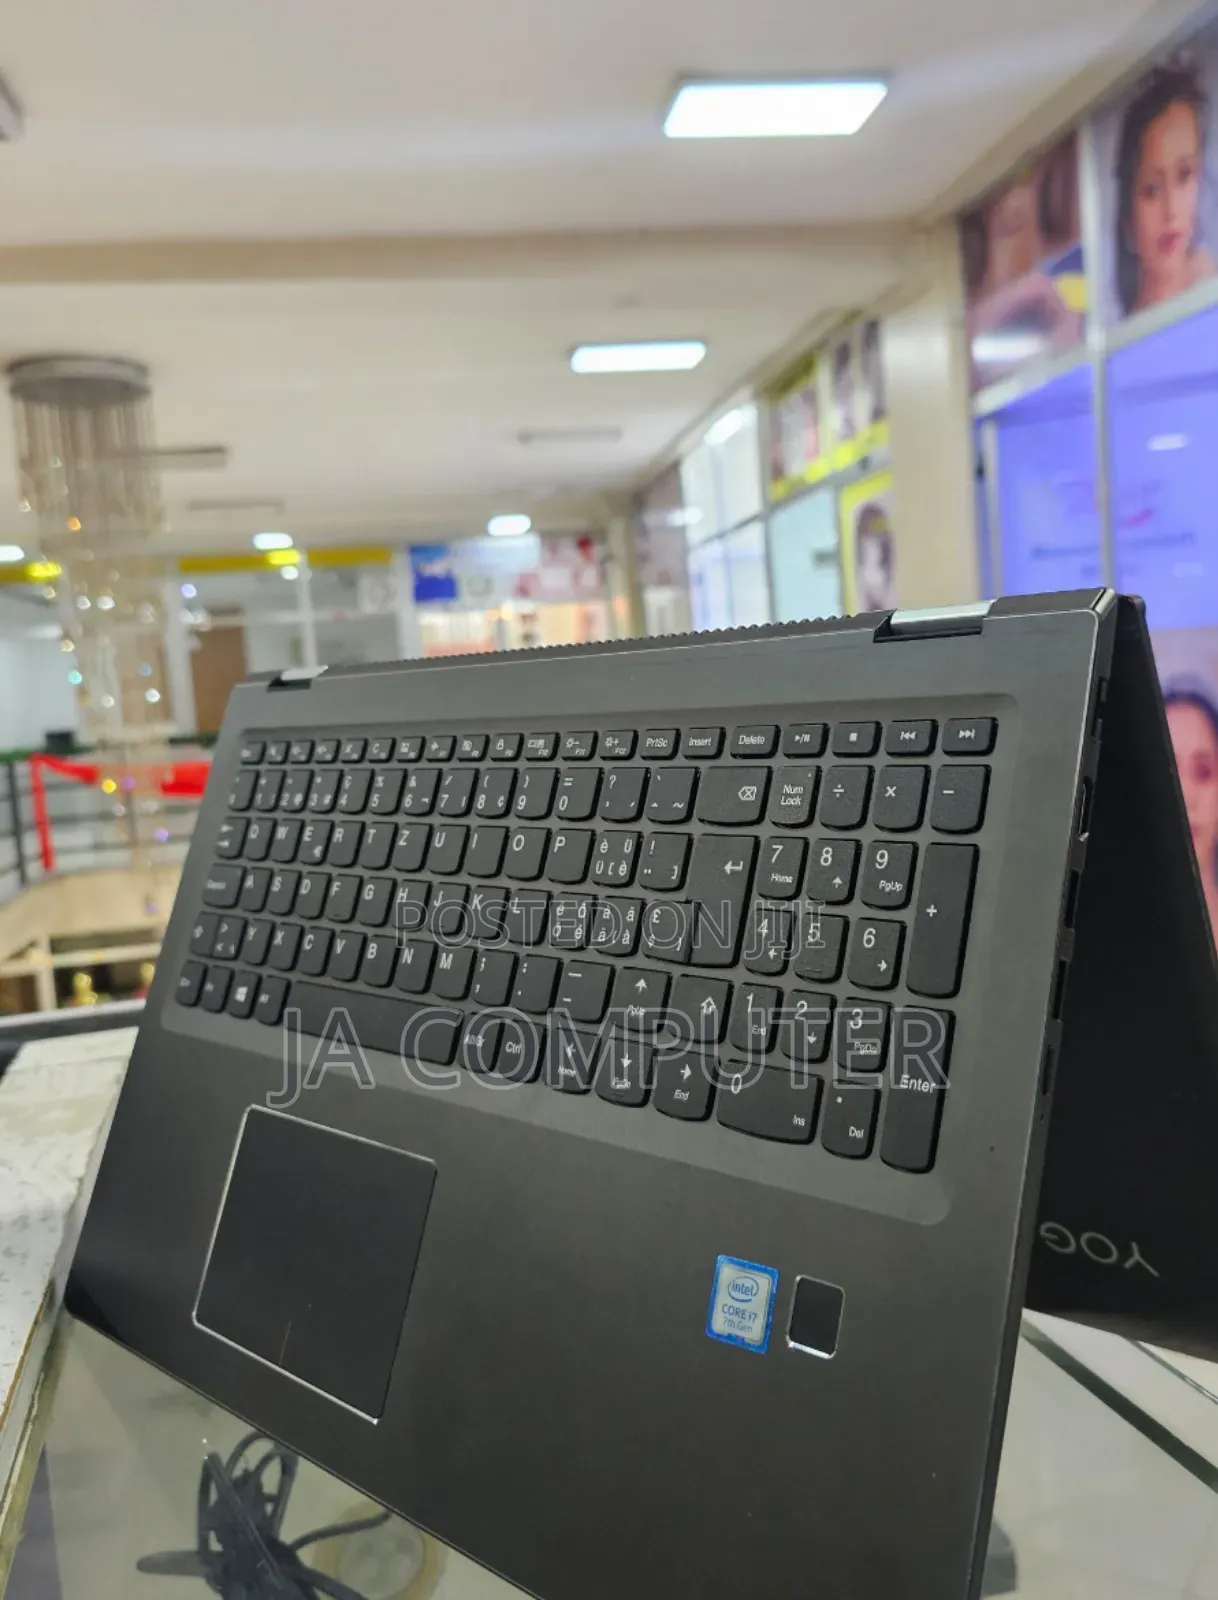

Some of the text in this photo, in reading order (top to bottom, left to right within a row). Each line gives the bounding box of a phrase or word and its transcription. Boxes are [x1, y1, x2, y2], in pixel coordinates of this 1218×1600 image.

[645, 737, 668, 748] PrtSc
[689, 737, 712, 746] Insert
[738, 735, 765, 745] Delete
[484, 775, 489, 788] (
[524, 775, 529, 788] )
[564, 777, 574, 786] =
[609, 775, 616, 789] ?
[783, 784, 804, 794] Num
[280, 792, 290, 806] 2
[309, 793, 318, 806] 3
[340, 793, 348, 806] 4
[371, 793, 380, 807] 5
[404, 793, 413, 808] 6
[440, 794, 449, 808] 7
[477, 794, 486, 809] 8
[517, 795, 526, 810] 9
[559, 795, 568, 811] 0
[780, 796, 802, 805] Lock
[276, 826, 289, 840] W
[304, 826, 314, 842] E
[334, 827, 344, 843] R
[368, 828, 376, 844] T
[398, 829, 410, 846] Z
[434, 831, 446, 848] U
[472, 833, 478, 849] I
[513, 834, 525, 851] O
[554, 836, 566, 853] P
[649, 840, 655, 855] !
[771, 845, 783, 863] 7
[820, 846, 833, 867] 8
[875, 850, 889, 869] 9
[671, 865, 678, 880] ]
[771, 873, 794, 884] Home
[244, 875, 254, 888] A
[271, 876, 283, 892] S
[300, 879, 311, 894] D
[331, 881, 341, 897] F
[879, 880, 903, 892] PgUp
[364, 884, 375, 900] G
[397, 887, 408, 903] H
[434, 890, 444, 906] J
[472, 894, 484, 910] K
[513, 897, 521, 914] L
[926, 904, 937, 917] +
[247, 926, 258, 940] Y
[757, 919, 768, 939] 4
[808, 923, 821, 942] 5
[273, 930, 285, 945] X
[304, 934, 314, 950] C
[863, 928, 876, 948] 6
[336, 938, 346, 954] V
[367, 943, 378, 959] B
[402, 948, 414, 964] N
[440, 952, 454, 970] M
[746, 993, 754, 1013] 1
[794, 1000, 808, 1020] 2
[849, 1008, 863, 1029] 3
[731, 1074, 742, 1094] 0
[900, 1074, 936, 1093] Enter
[674, 1089, 690, 1100] End
[793, 1115, 805, 1126] Ins
[848, 1126, 864, 1138] Del
[731, 1280, 754, 1297] intel
[722, 1303, 747, 1320] CORE
[737, 1321, 752, 1332] Gen
